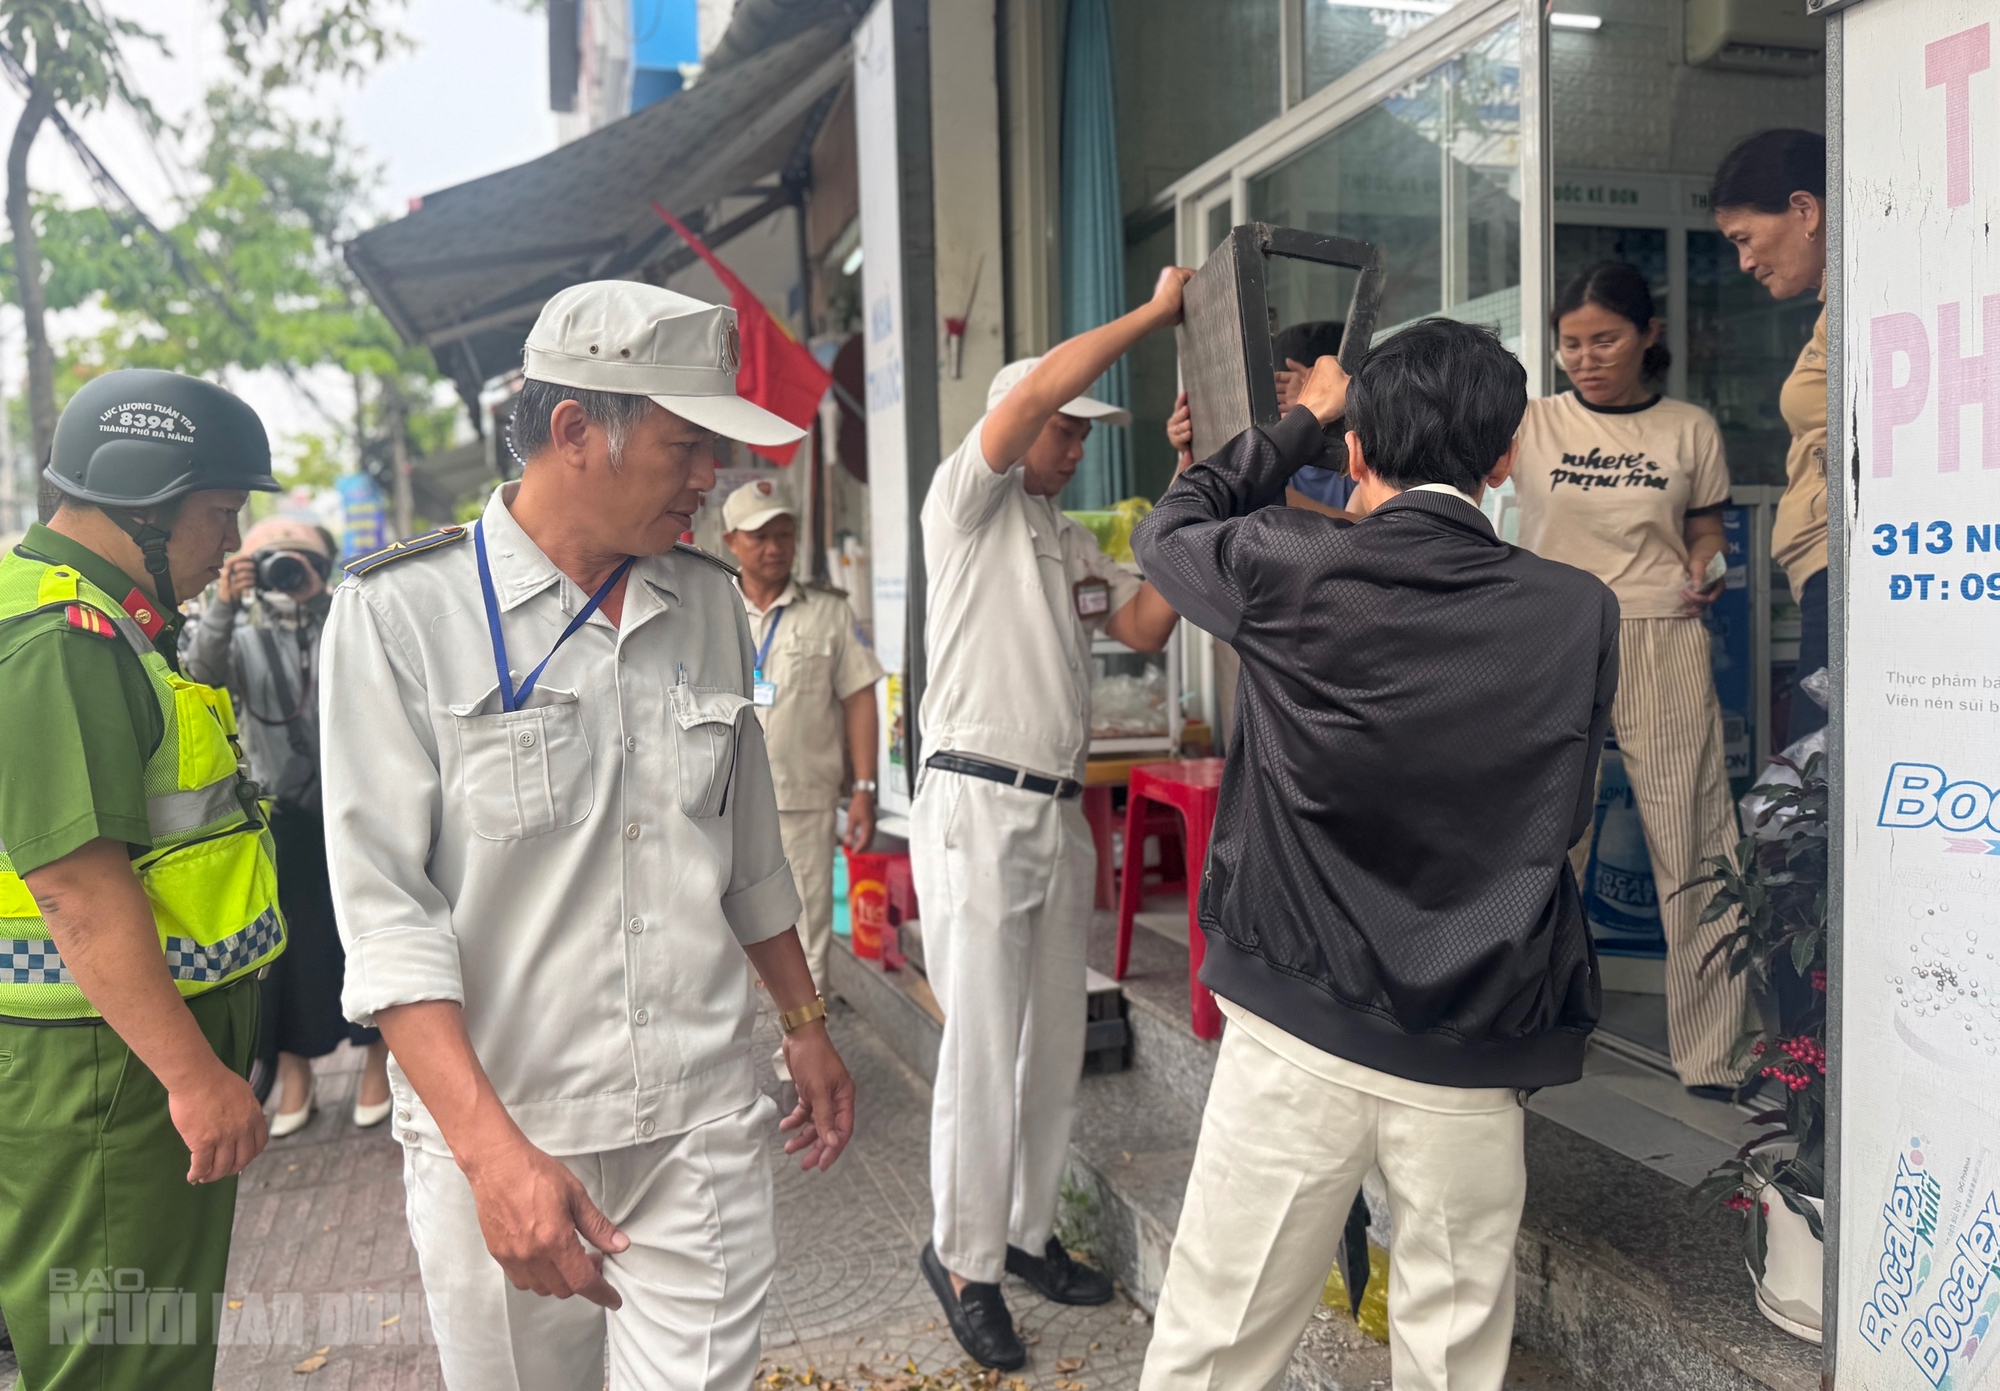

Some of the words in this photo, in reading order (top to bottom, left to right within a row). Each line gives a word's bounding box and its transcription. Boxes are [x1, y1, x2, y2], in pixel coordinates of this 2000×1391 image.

[100, 407, 118, 422] LỰC
[118, 402, 152, 411] LƯỢNG
[179, 414, 196, 433] TRA
[119, 411, 175, 432] 8394
[99, 424, 129, 434] THÀNH
[130, 426, 150, 437] PHỐ
[152, 429, 165, 438] ĐÀ
[1871, 520, 1954, 556] 313
[1966, 523, 2000, 553] N
[1886, 671, 1927, 687] Thực
[1932, 672, 1977, 688] phẩm
[1885, 693, 1919, 708] Viên
[1924, 697, 1953, 710] nén
[1959, 698, 1983, 712] sủi
[1724, 753, 1748, 769] ON
[1877, 762, 2000, 833] Bo
[1916, 1169, 1941, 1249] Multi
